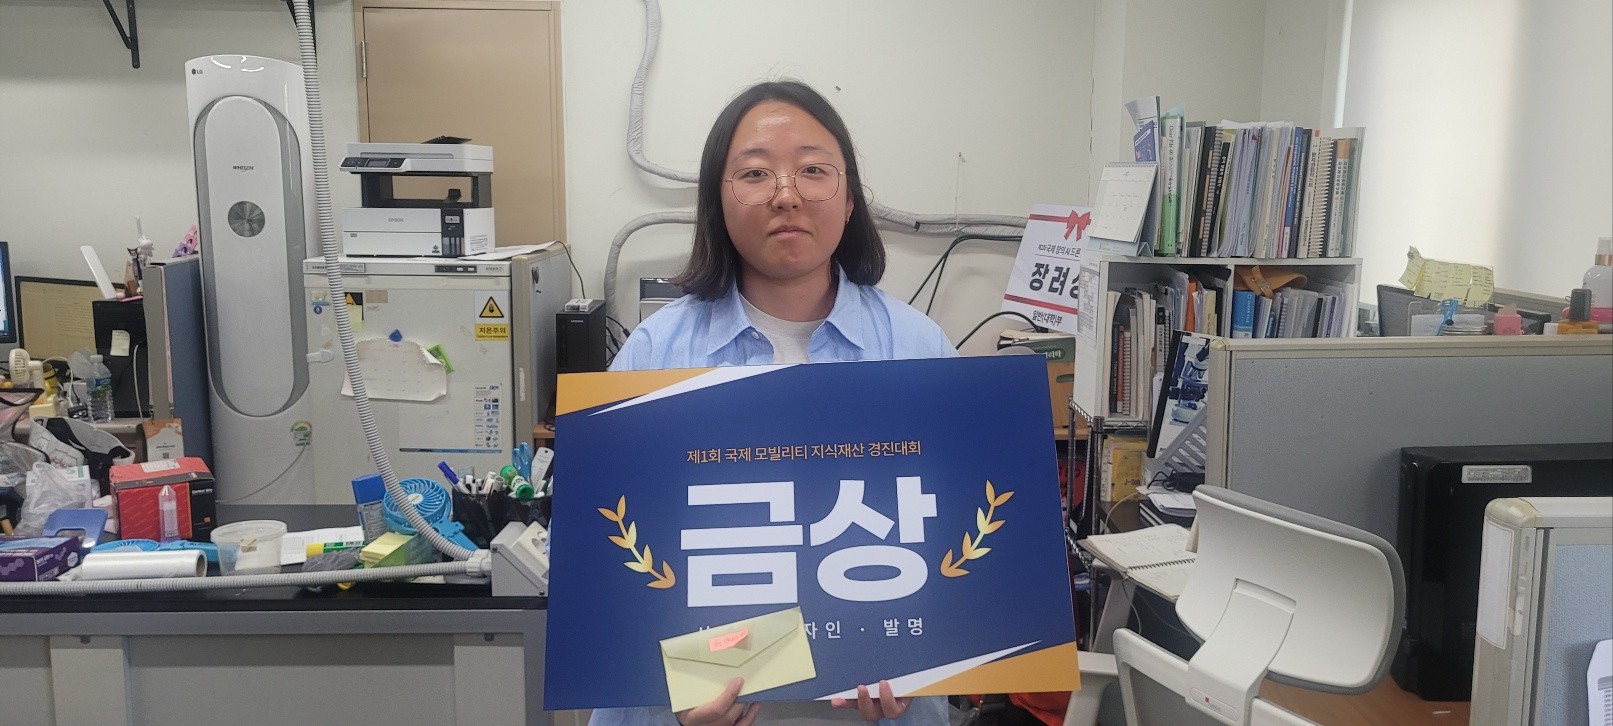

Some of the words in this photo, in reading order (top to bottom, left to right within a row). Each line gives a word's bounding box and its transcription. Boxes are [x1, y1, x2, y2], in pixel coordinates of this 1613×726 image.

[686, 448, 721, 464] 제1회
[724, 447, 751, 462] 국제
[754, 445, 808, 461] 모빌리티
[811, 442, 865, 459] 지식재산
[867, 440, 922, 457] 경진대회
[680, 476, 938, 608] 금상
[804, 620, 841, 639] 자인
[883, 617, 923, 637] 발명
